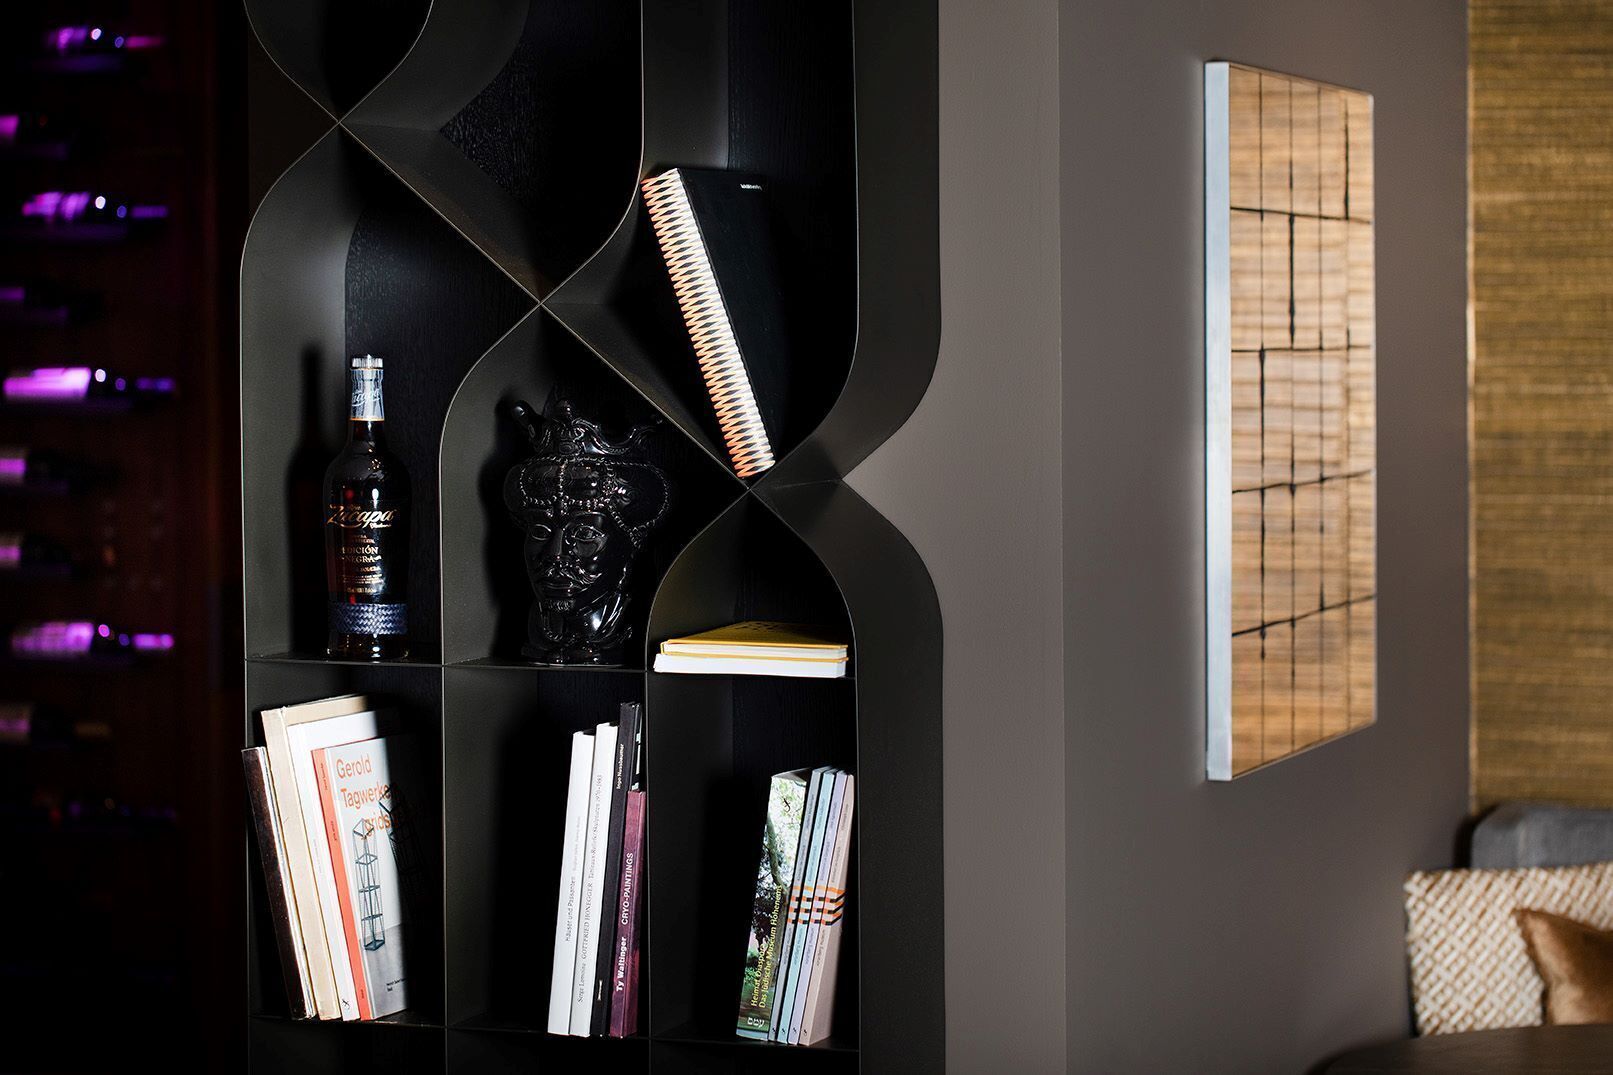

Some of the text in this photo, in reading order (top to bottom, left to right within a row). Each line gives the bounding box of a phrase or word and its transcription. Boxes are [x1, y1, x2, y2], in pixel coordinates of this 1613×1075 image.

[336, 753, 372, 779] Gerold
[616, 852, 634, 992] Ty Waltinger CRYO-PAINTINGS
[751, 979, 760, 1006] Heimat
[759, 993, 767, 1008] Das
[767, 927, 777, 960] Museum
